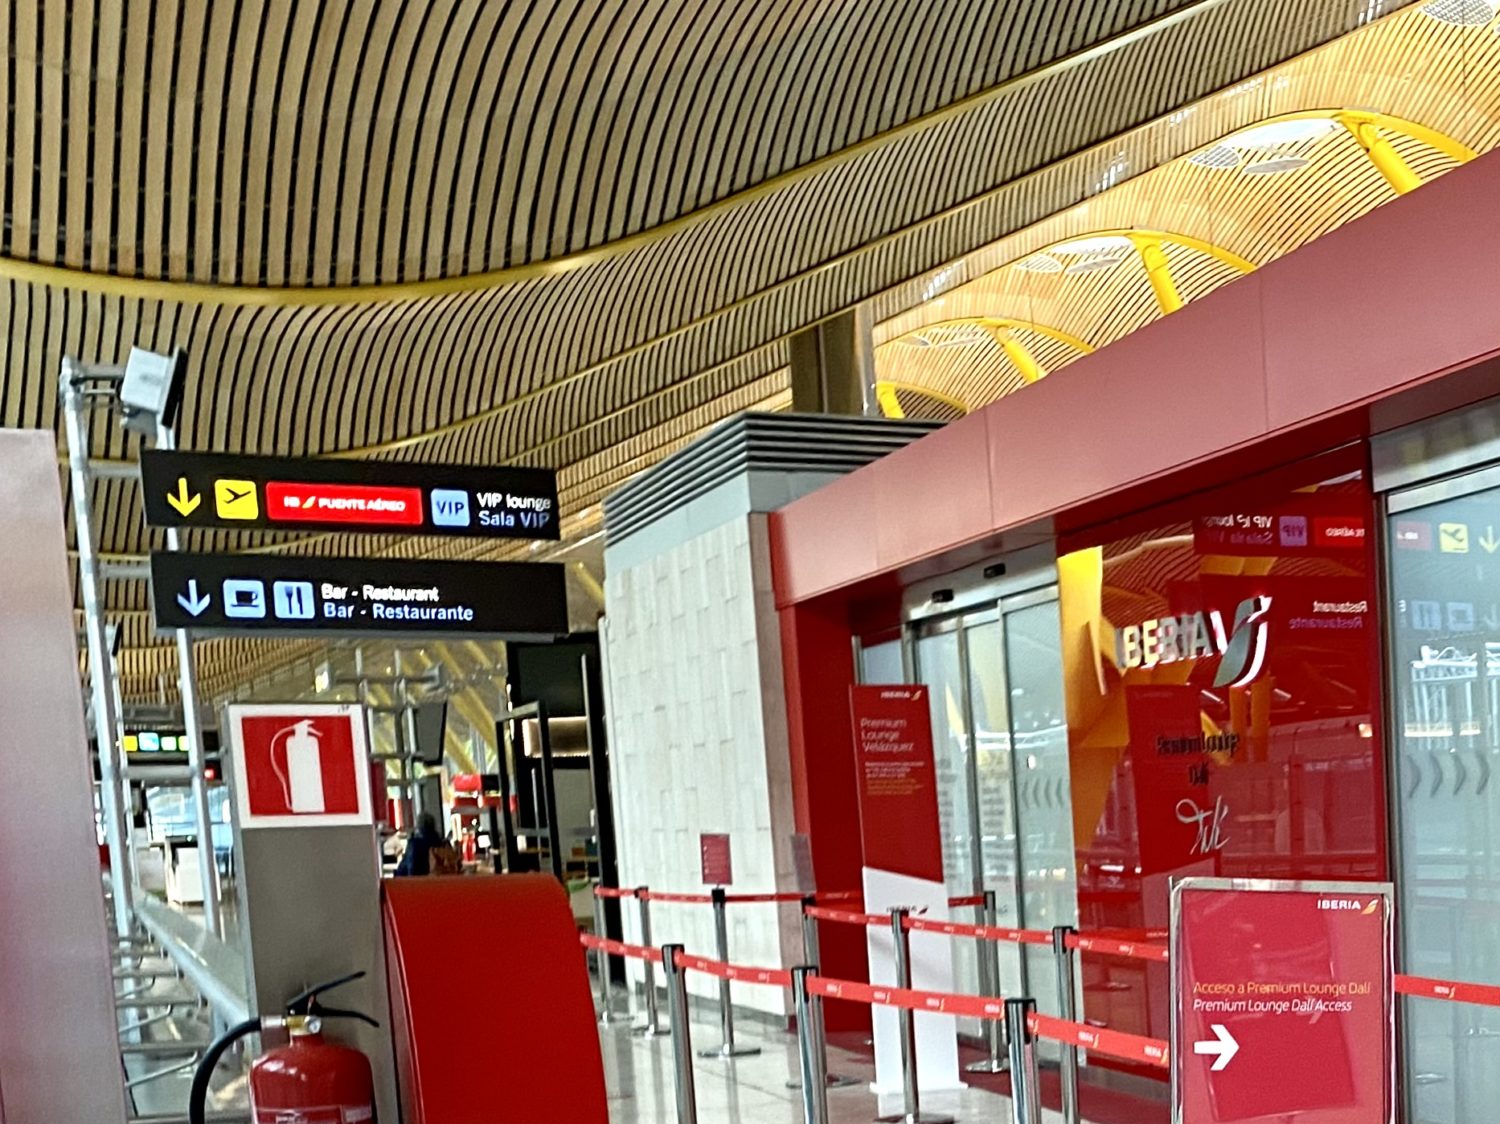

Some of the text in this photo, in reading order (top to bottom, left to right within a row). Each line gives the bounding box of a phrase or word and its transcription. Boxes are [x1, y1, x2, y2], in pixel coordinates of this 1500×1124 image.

[318, 498, 366, 510] PUENTE
[437, 501, 464, 515] VIP
[476, 492, 551, 511] VIP lounge
[478, 510, 549, 528] Sala VIP
[321, 583, 348, 599] Bar
[363, 585, 439, 602] Restaurant
[324, 602, 354, 618] Bar
[373, 603, 473, 621] Restaurante
[1317, 900, 1361, 910] IBERIA
[1193, 982, 1371, 997] Acceso a Premium Lounge Dalí
[1193, 999, 1246, 1012] Premium
[1248, 999, 1290, 1015] Lounge
[1314, 1000, 1352, 1012] Access
